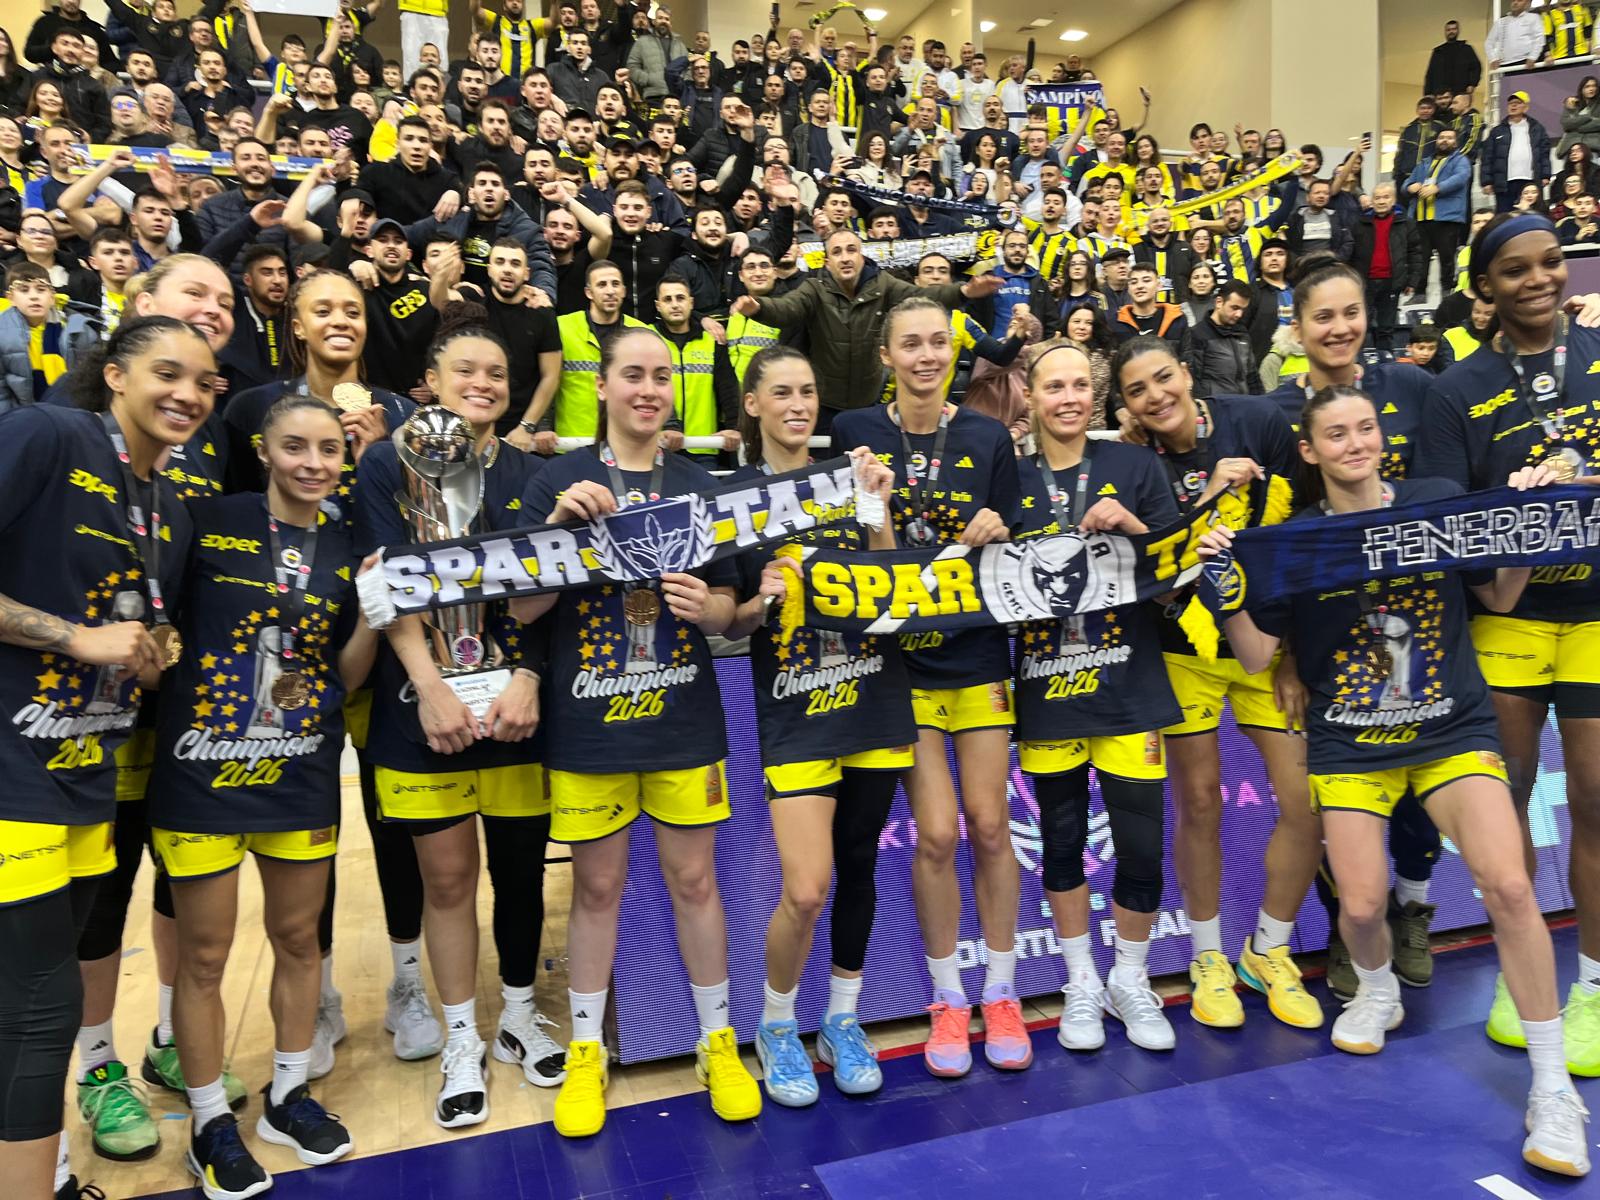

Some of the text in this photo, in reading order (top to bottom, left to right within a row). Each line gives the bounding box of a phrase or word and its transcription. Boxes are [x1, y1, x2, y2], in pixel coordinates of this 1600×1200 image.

[383, 528, 590, 609] SPAR
[811, 558, 982, 619] SPAR
[572, 663, 698, 703] Champions
[772, 654, 884, 700] Champions
[1044, 668, 1101, 699] 2026
[603, 688, 665, 723] 2026
[805, 679, 860, 716] 2026
[1324, 697, 1455, 732] Champions
[173, 727, 326, 772] Champions
[211, 758, 289, 789] 2026
